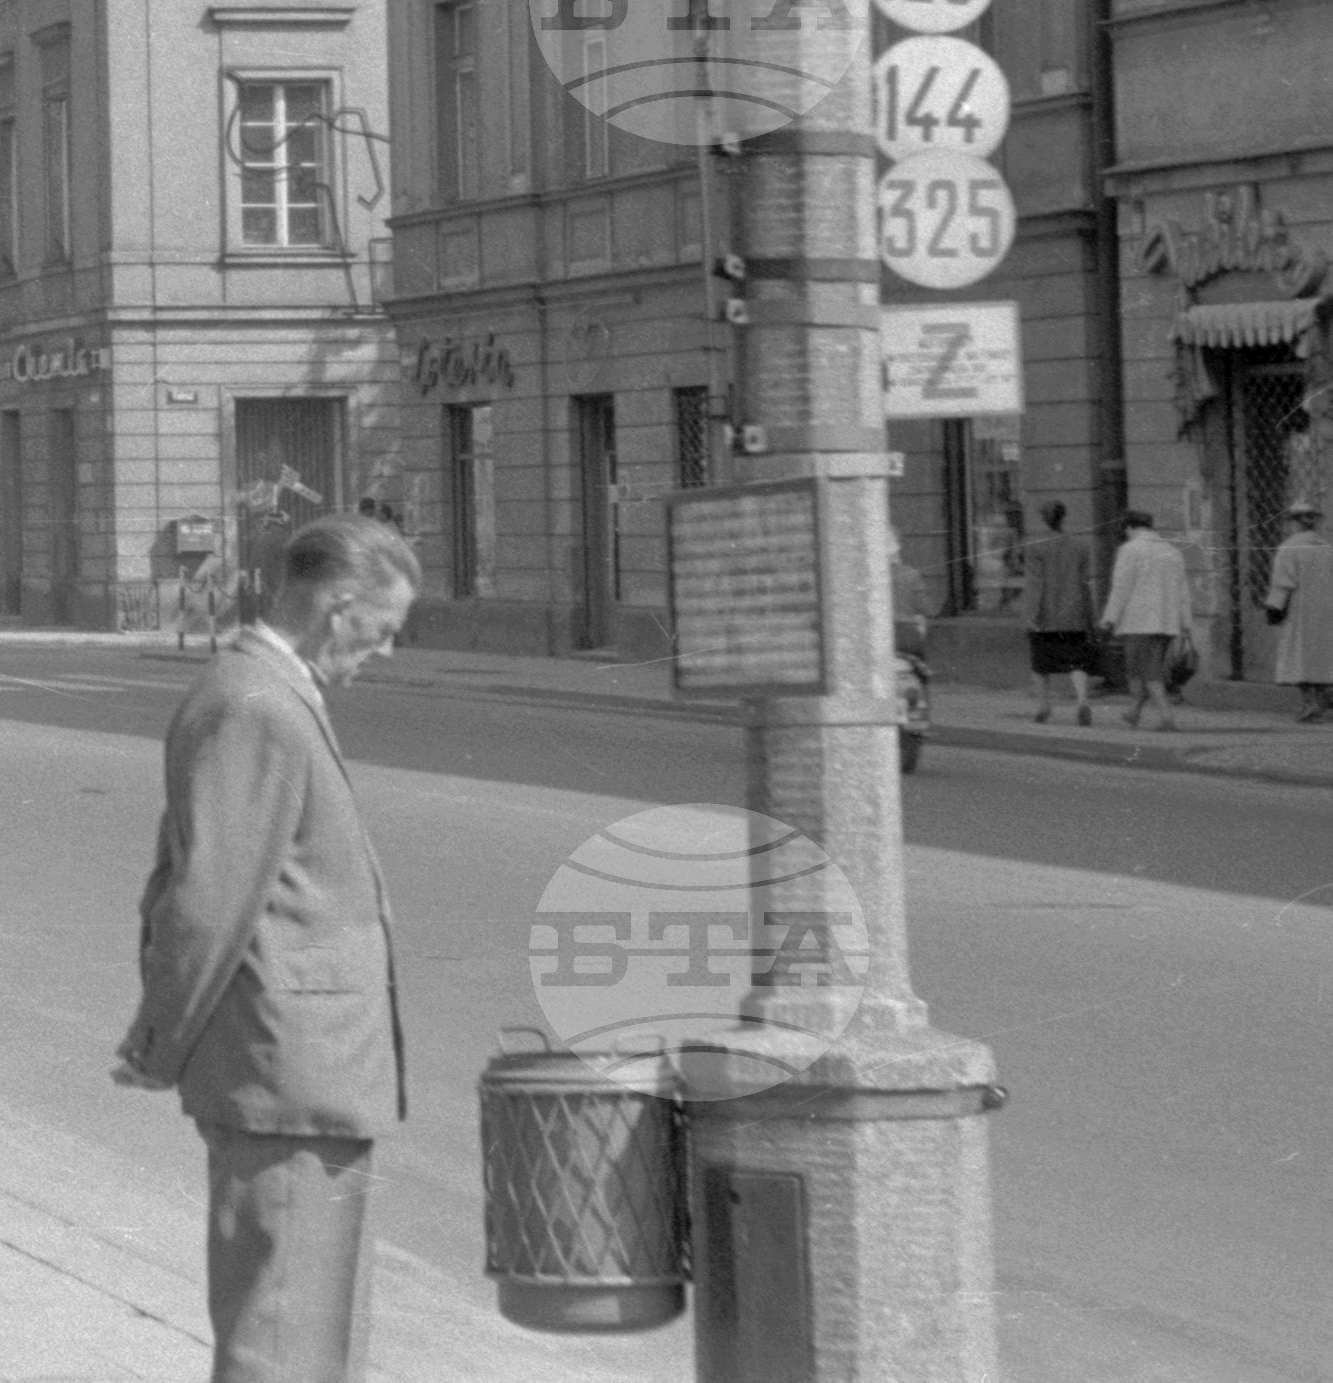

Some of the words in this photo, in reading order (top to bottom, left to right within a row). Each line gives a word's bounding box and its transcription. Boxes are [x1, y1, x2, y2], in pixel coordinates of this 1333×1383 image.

[886, 65, 982, 144] 144
[885, 179, 1004, 259] 325
[920, 322, 979, 399] Z
